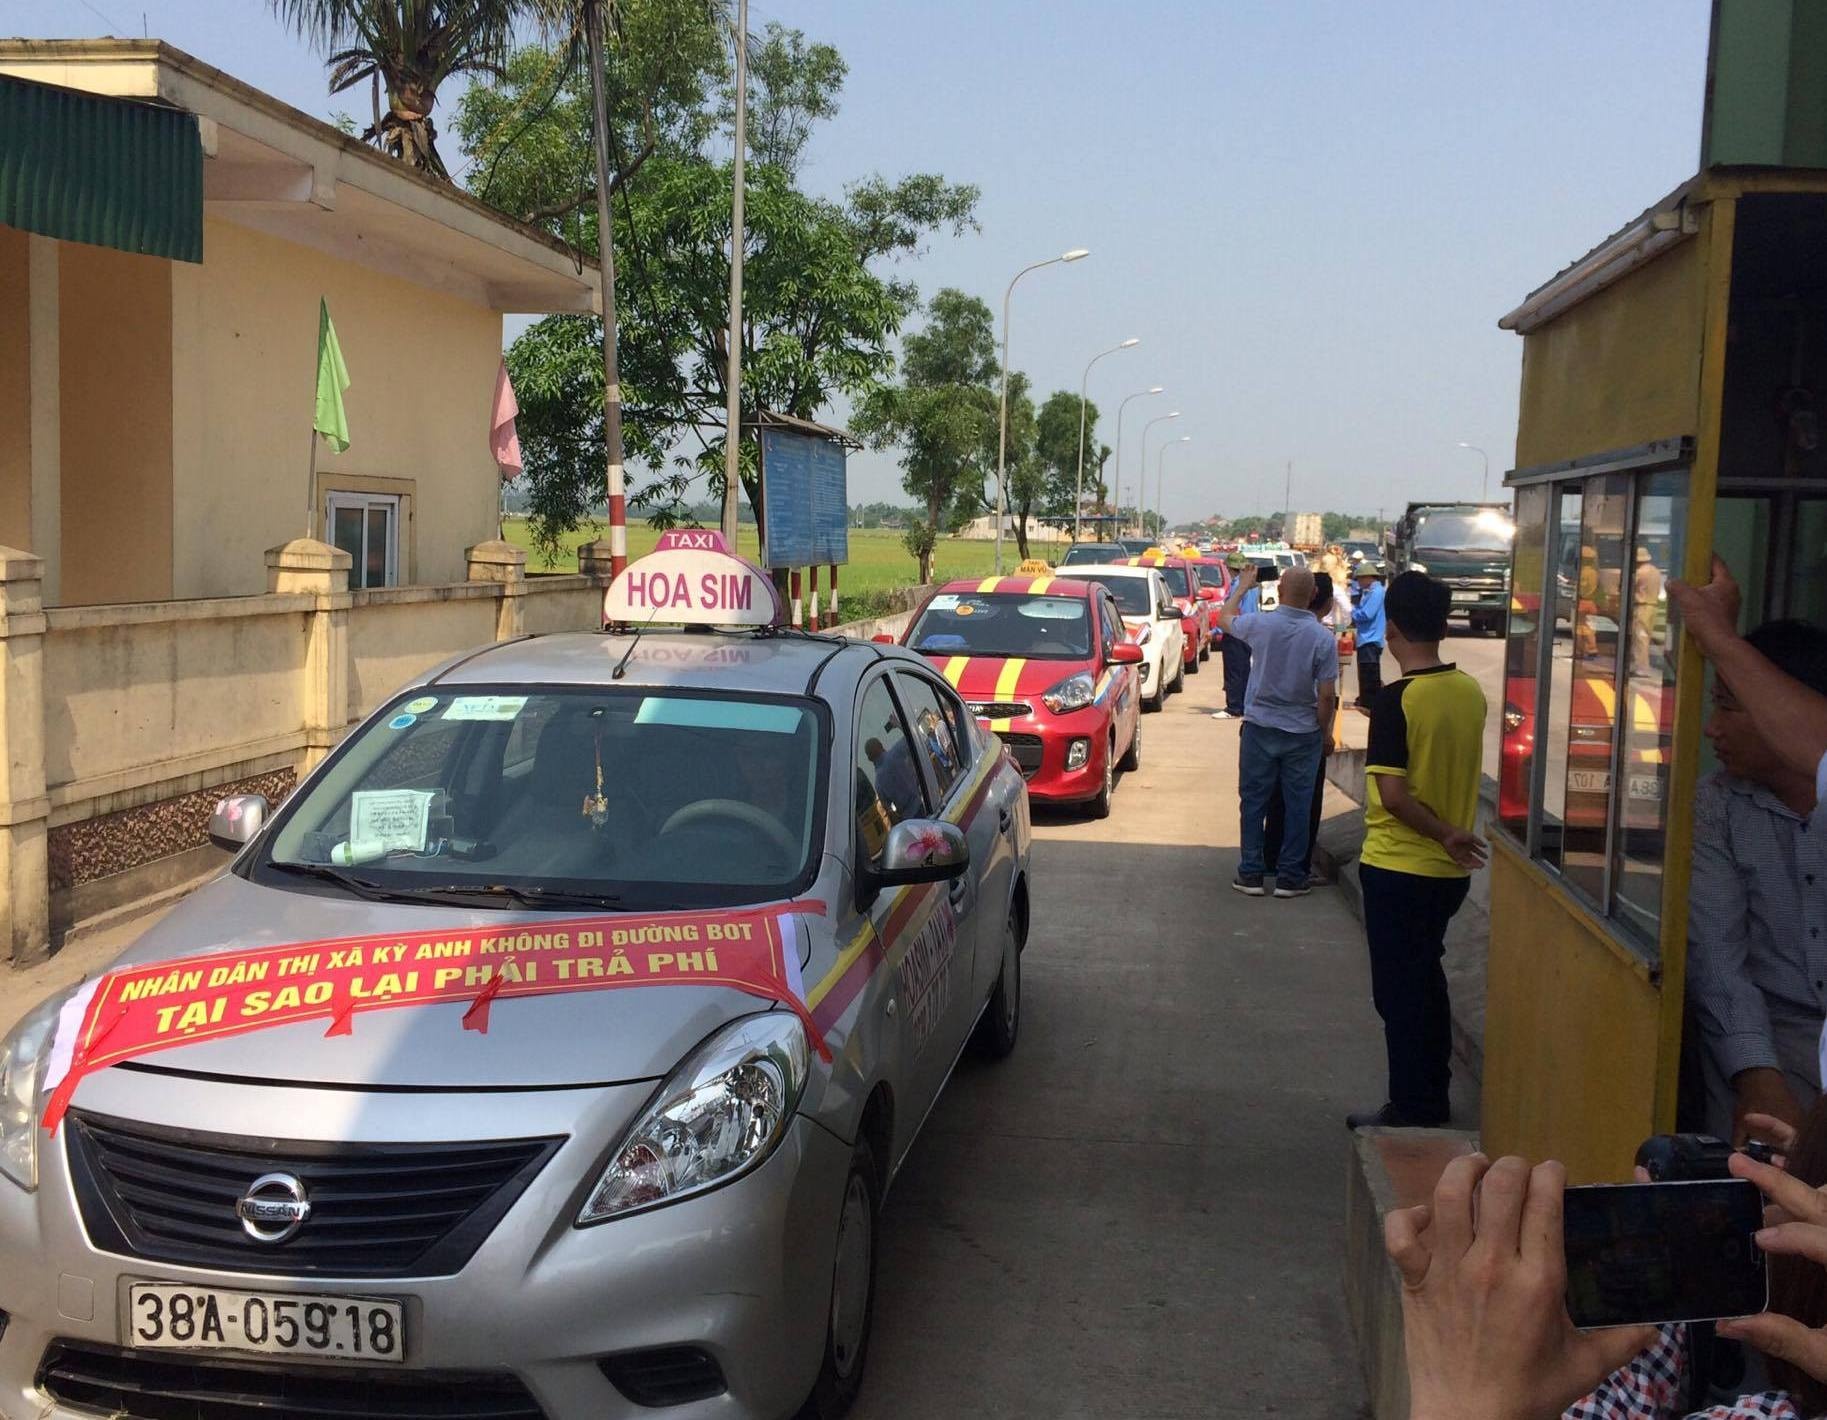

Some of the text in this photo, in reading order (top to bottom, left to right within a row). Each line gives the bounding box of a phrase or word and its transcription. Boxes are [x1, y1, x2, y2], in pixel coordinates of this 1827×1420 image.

[666, 533, 714, 548] TAXI
[627, 572, 752, 611] HOA SIM
[119, 970, 203, 1003] NHÂN
[208, 960, 270, 988] DÂN
[277, 952, 320, 977] THỊ
[326, 945, 364, 969] XÃ
[414, 939, 472, 960] ANH
[479, 930, 570, 954] KHÔNG
[577, 930, 603, 949] ĐI
[611, 923, 699, 945] ĐƯỜNG
[706, 922, 754, 942] BOT
[155, 946, 719, 1035] TẠI SAO LẠI PHẢI TRẢ PHÍ
[240, 1202, 301, 1217] NISSAN
[137, 1292, 396, 1355] 38A-059.18
